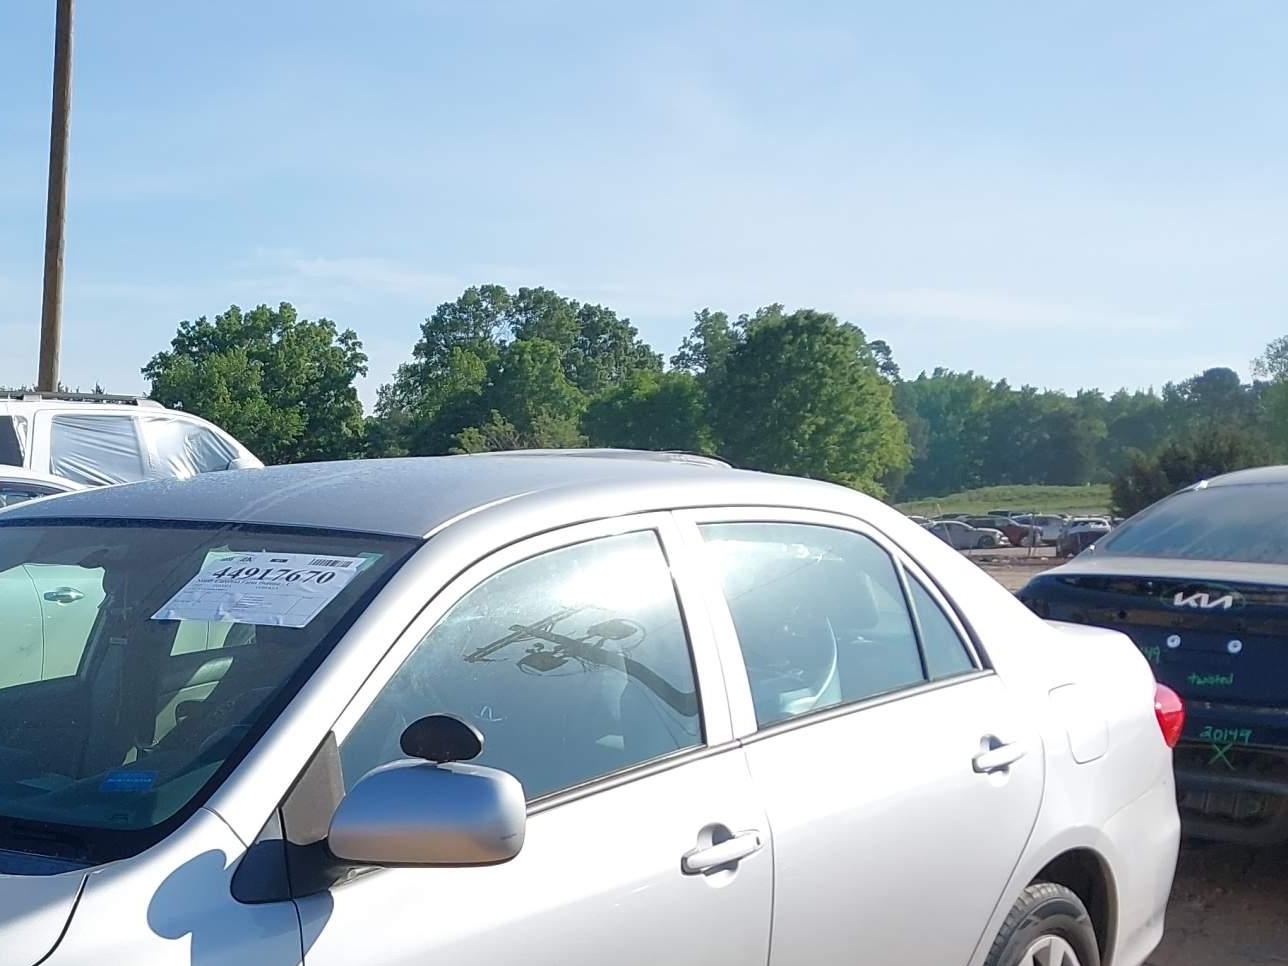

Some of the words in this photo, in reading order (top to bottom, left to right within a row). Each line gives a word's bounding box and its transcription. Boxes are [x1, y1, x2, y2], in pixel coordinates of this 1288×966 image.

[212, 566, 336, 585] 44917670
[1173, 591, 1233, 610] KIA
[1199, 725, 1253, 745] 20149
